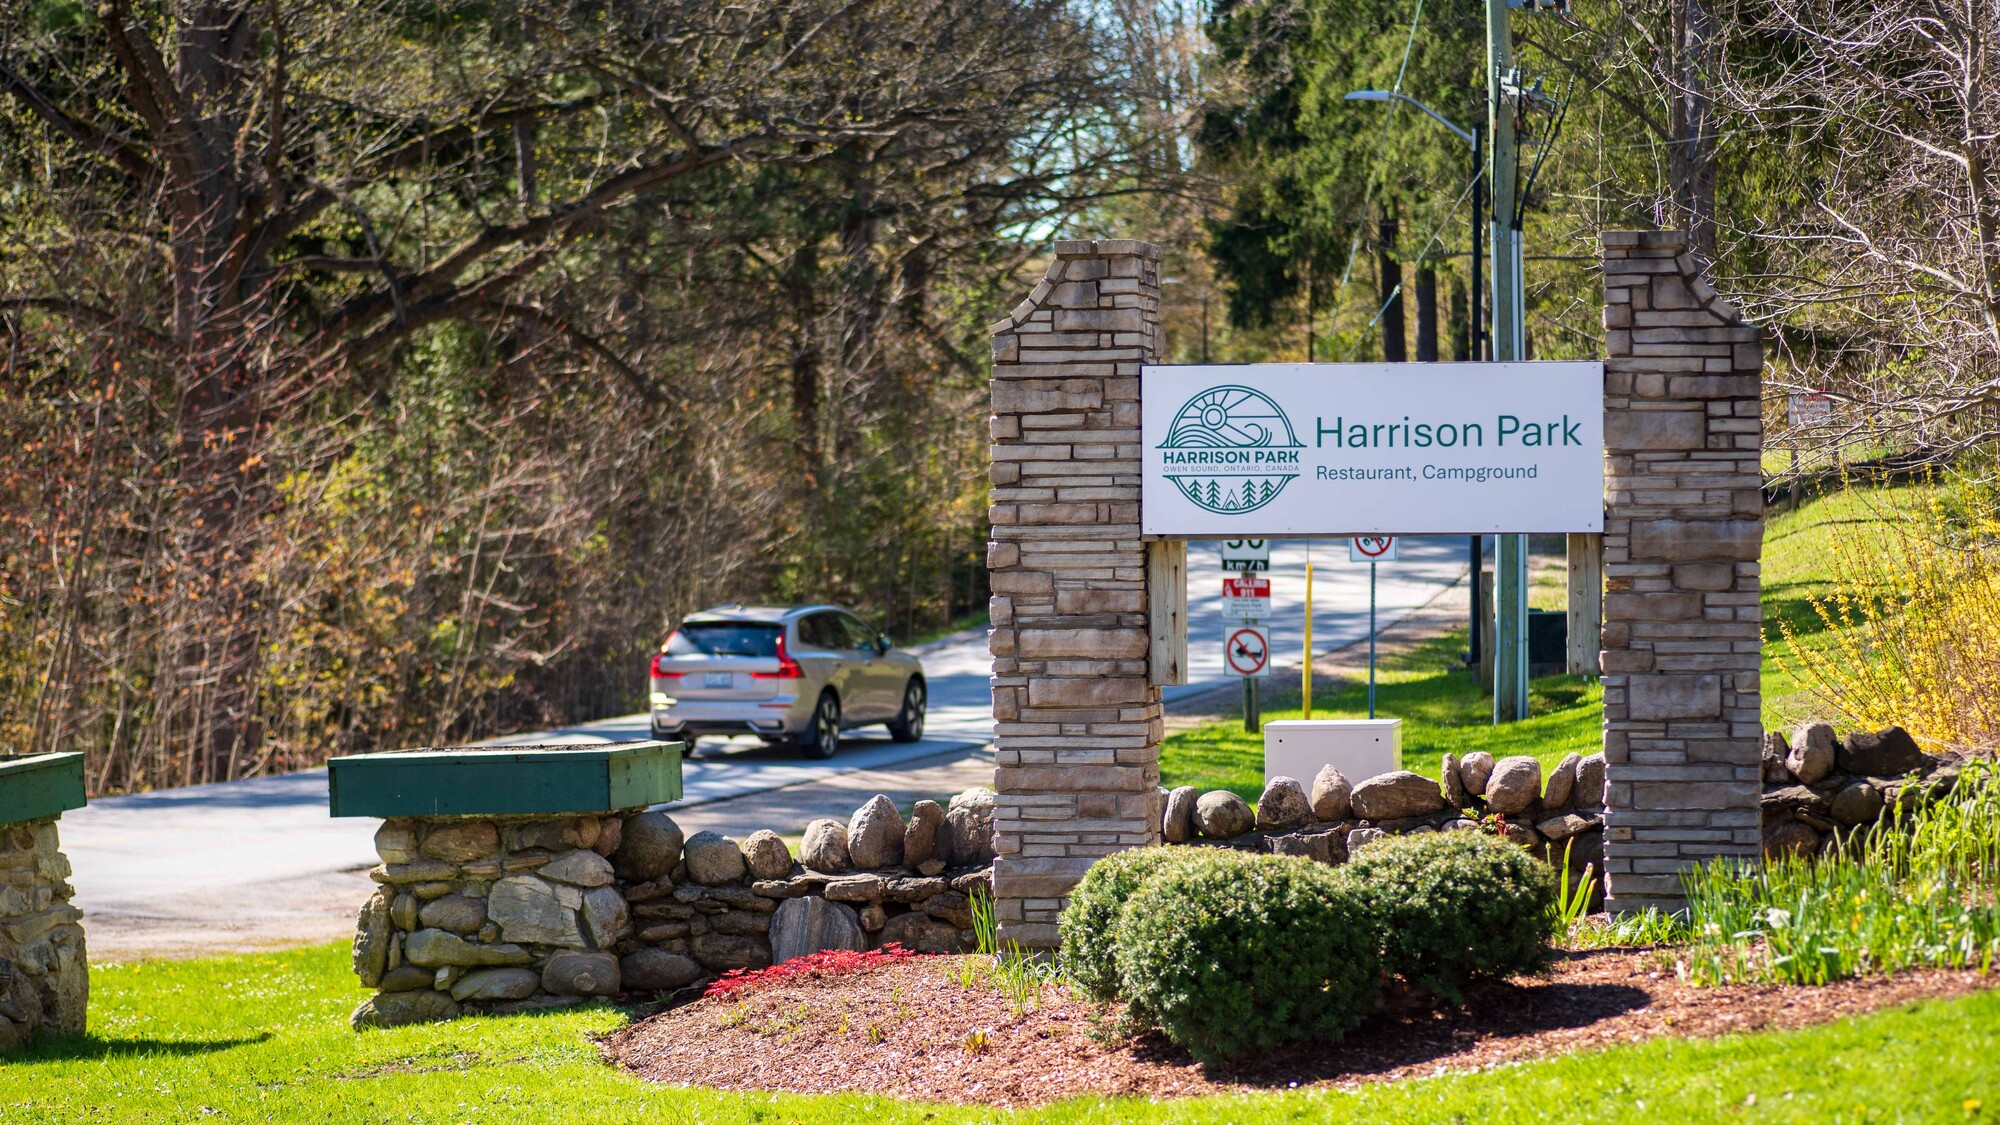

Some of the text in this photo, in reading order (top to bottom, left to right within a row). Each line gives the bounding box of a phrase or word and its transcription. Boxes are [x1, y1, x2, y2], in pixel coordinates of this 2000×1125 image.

[1316, 414, 1583, 448] Harrison Park
[1163, 450, 1300, 464] HARRISON PARK
[1163, 465, 1188, 473] OWEN
[1190, 465, 1221, 473] SOUND,
[1265, 464, 1300, 472] CANADA
[1316, 464, 1538, 483] Restaurant, Campground
[1226, 560, 1265, 570] km/h
[1240, 588, 1255, 597] 911
